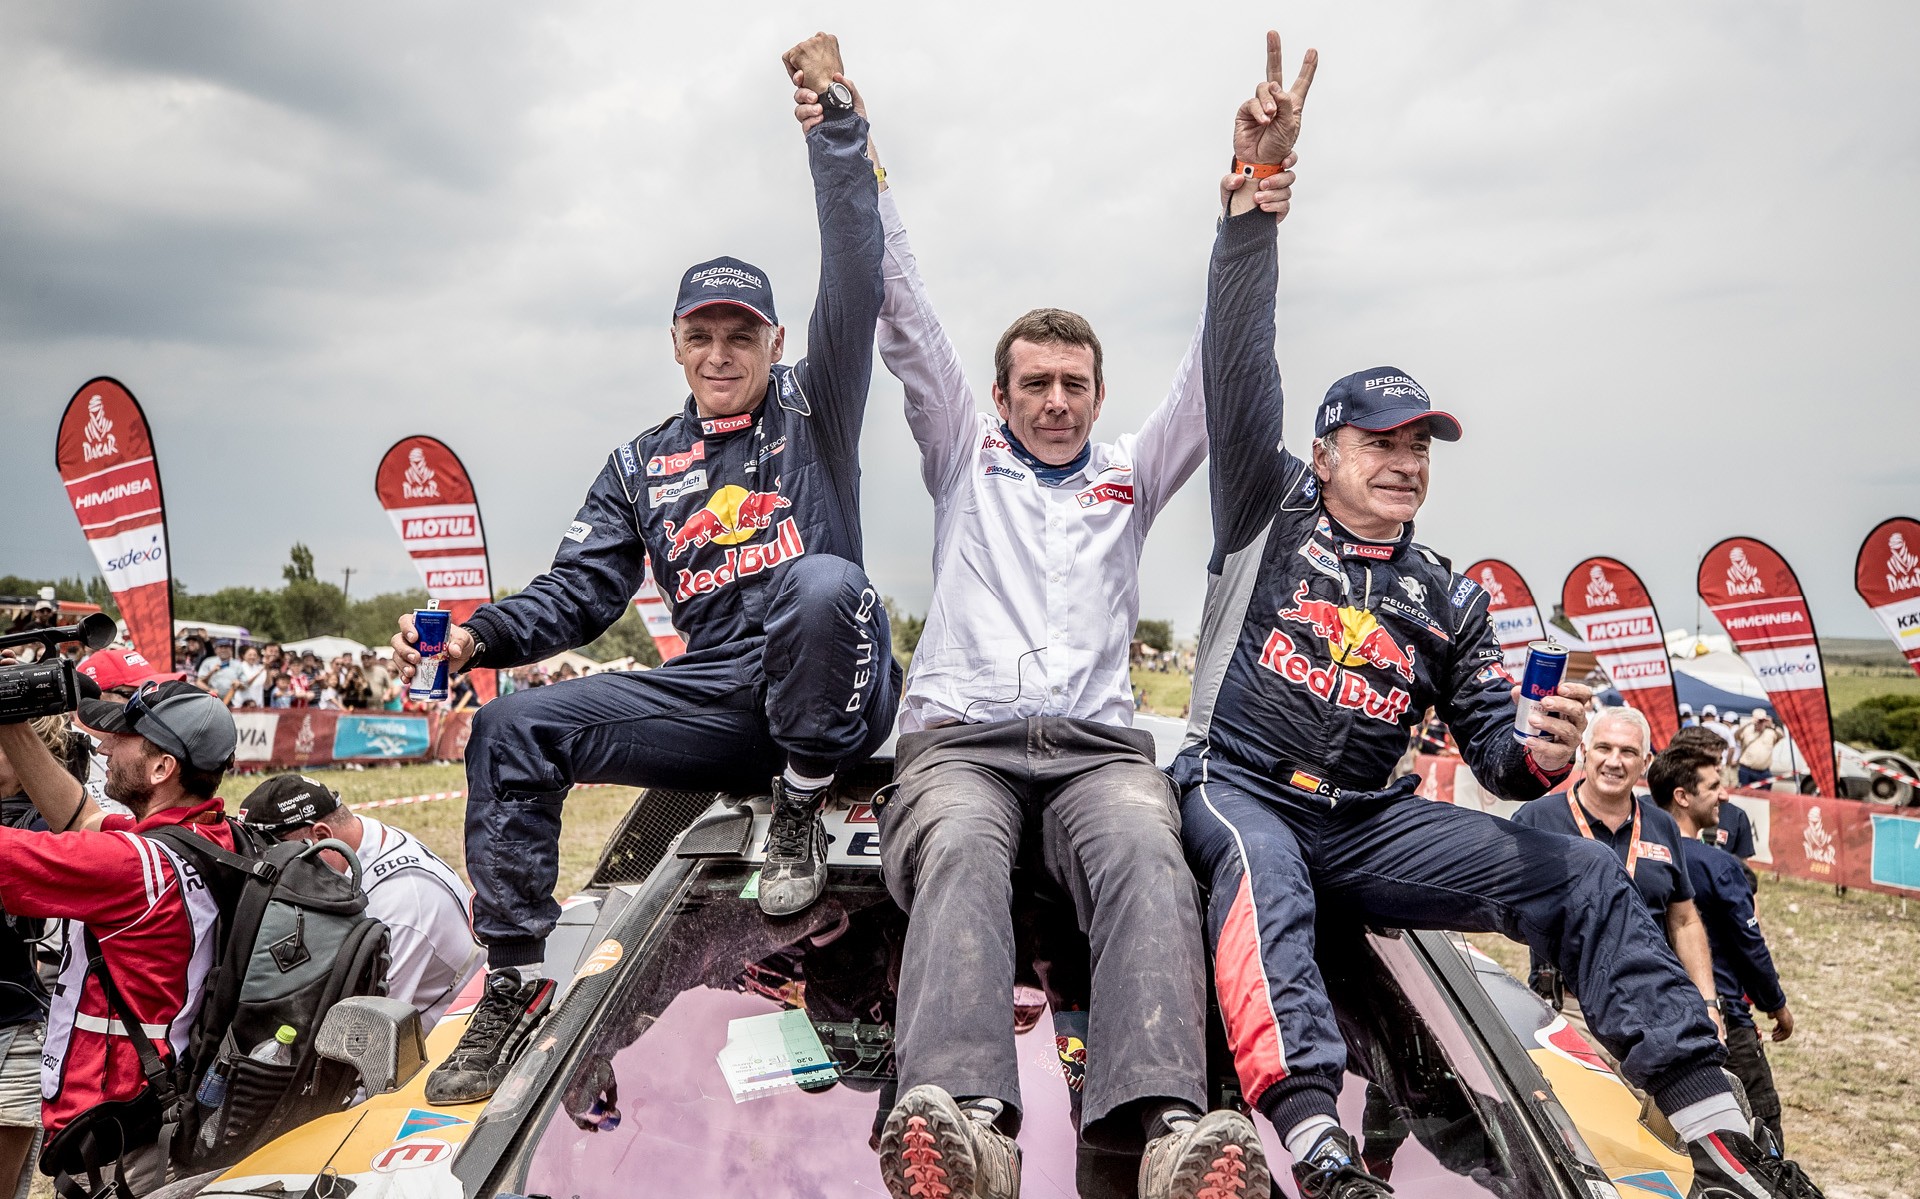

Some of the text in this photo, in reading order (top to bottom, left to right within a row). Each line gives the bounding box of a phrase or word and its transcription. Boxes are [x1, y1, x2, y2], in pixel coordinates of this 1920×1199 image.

[691, 266, 762, 286] BFGoodrich
[702, 277, 757, 290] RACING
[1383, 387, 1428, 402] RACING
[1325, 402, 1343, 426] 1st
[715, 418, 750, 430] TOTAL
[82, 433, 119, 463] DAKAR
[75, 476, 152, 511] HIMOINSA
[402, 479, 441, 501] DAKAR
[1095, 487, 1132, 500] TOTAL
[404, 516, 472, 539] MOTUL
[106, 540, 162, 572] sodexo
[676, 515, 805, 603] Red Bull
[1358, 547, 1391, 557] TOTAL
[428, 569, 484, 587] MOTUL
[1726, 576, 1765, 596] DAKAR
[1585, 590, 1620, 608] DAKAR
[1382, 596, 1430, 622] PEUGEOT
[1588, 617, 1653, 641] MOTUL
[1726, 611, 1804, 630] HIMOINSA
[1897, 613, 1920, 628] KÄ
[420, 642, 440, 653] Red
[1258, 627, 1412, 726] Red Bull
[1613, 661, 1665, 678] MOTUL
[1759, 658, 1816, 677] sodexo
[1531, 684, 1554, 697] Red
[277, 792, 311, 809] Innovation
[373, 855, 420, 877] 2018
